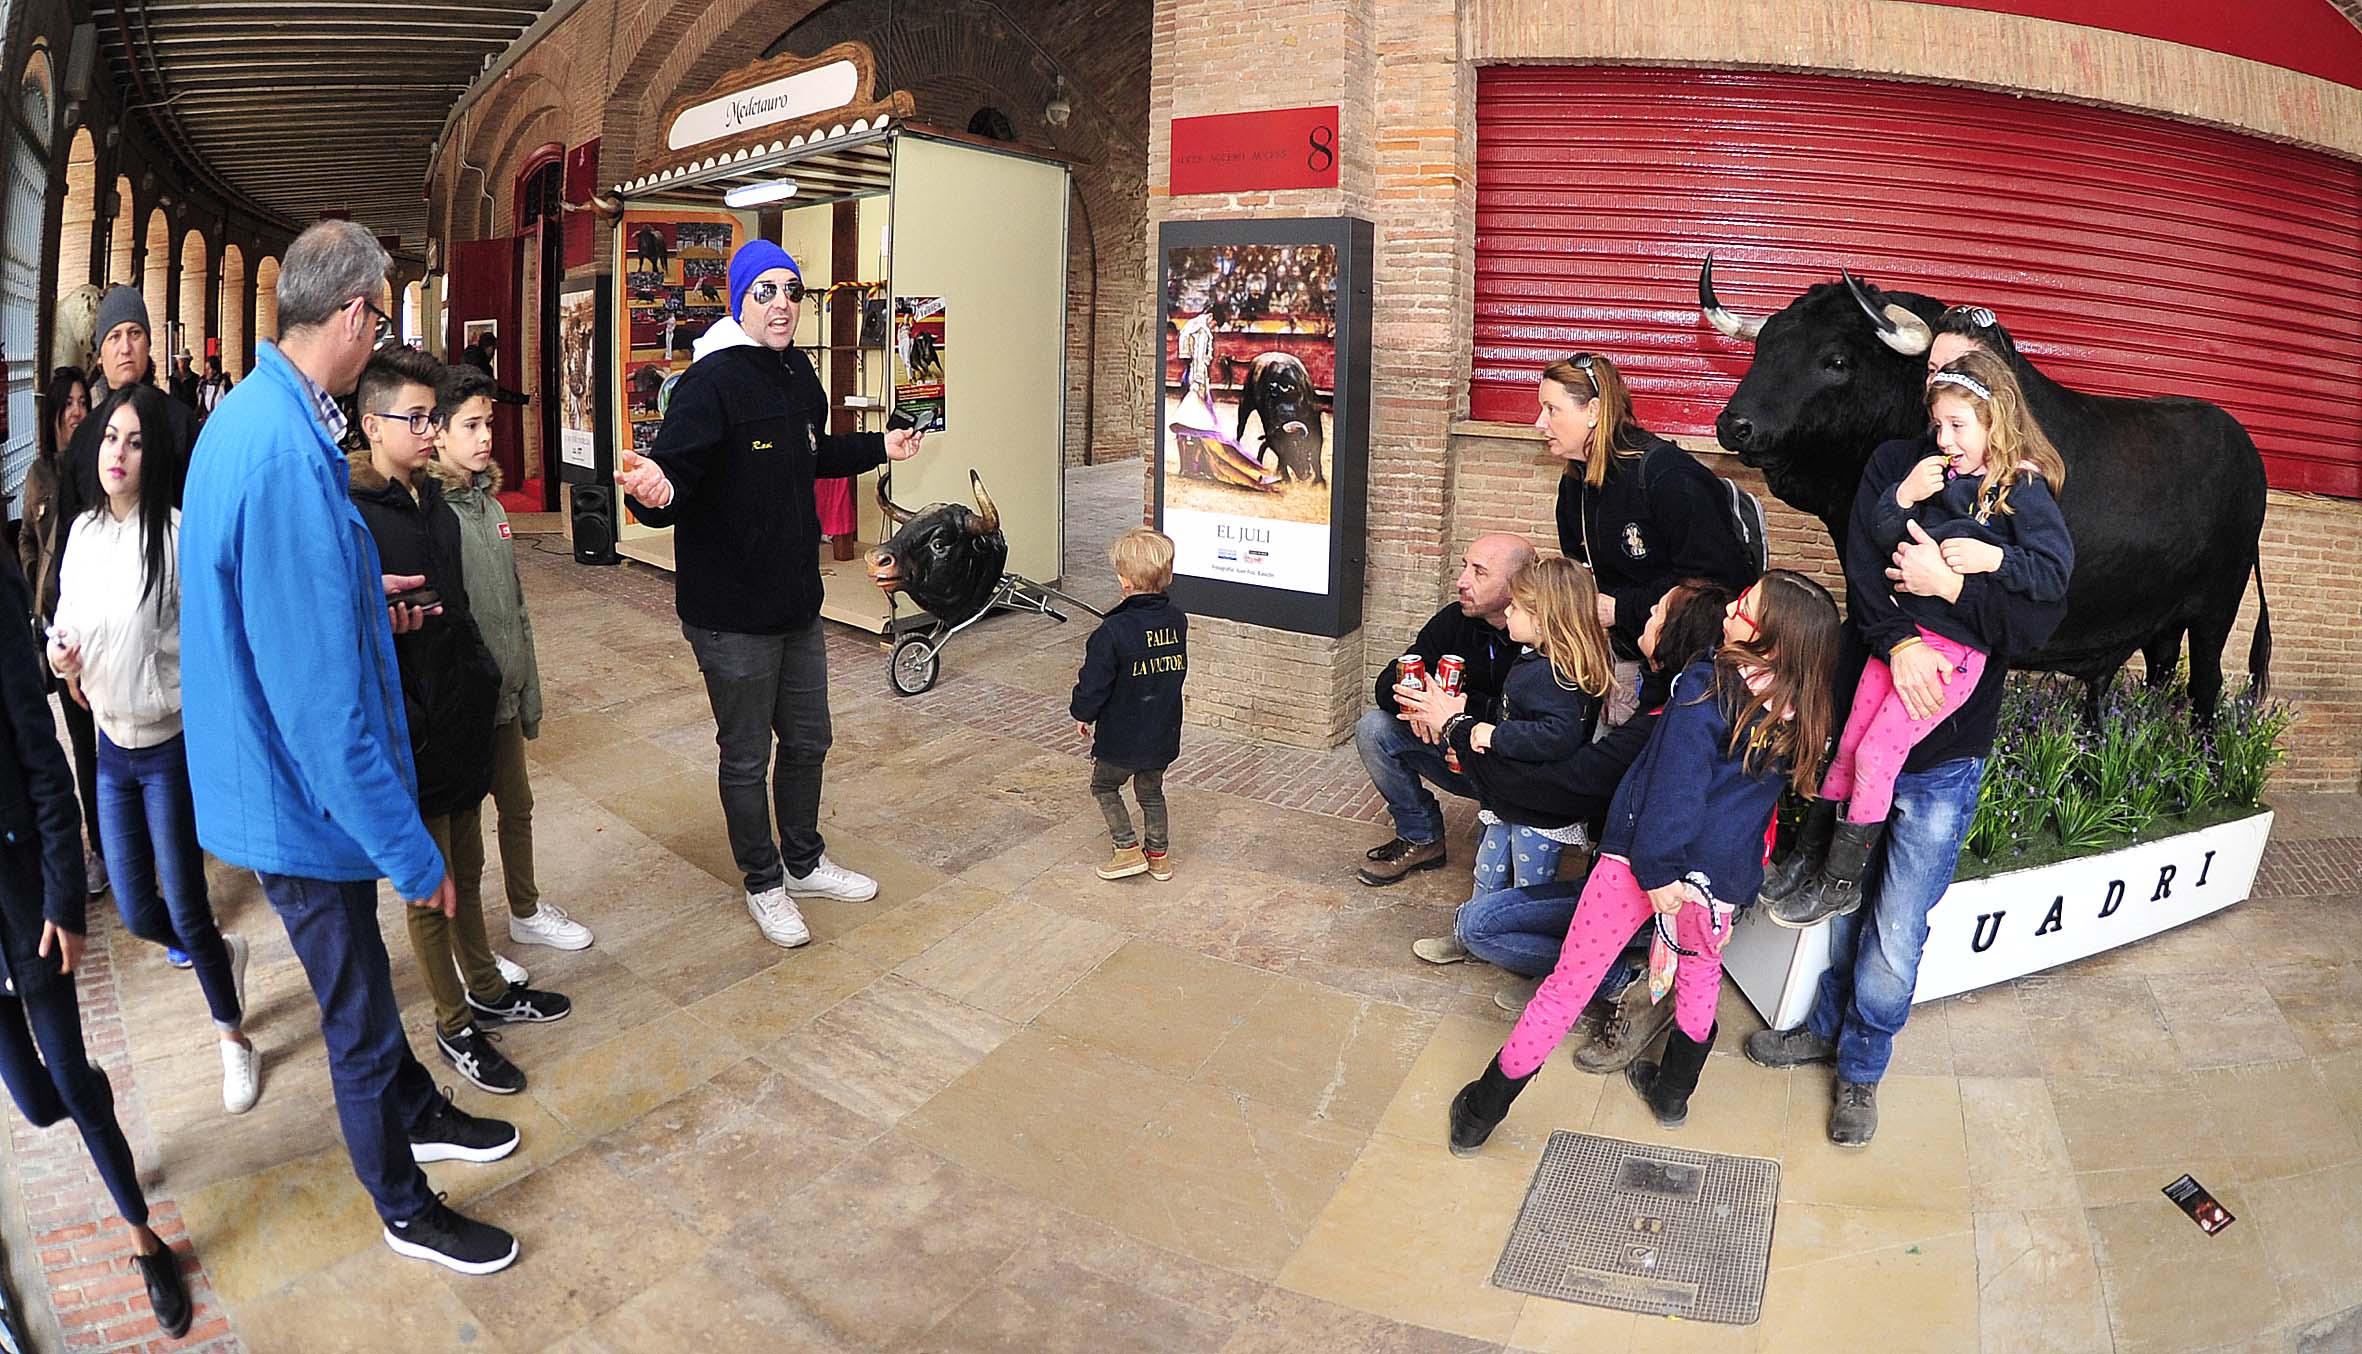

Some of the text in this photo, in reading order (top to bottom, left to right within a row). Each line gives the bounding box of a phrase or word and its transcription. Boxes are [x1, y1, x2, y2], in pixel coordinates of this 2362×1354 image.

[725, 94, 788, 128] Medetauro
[1307, 125, 1333, 173] 8
[1217, 524, 1270, 544] EL JULI
[1145, 628, 1179, 648] FALLA
[1132, 660, 1148, 677] LA
[1922, 850, 2216, 953] UADRI
